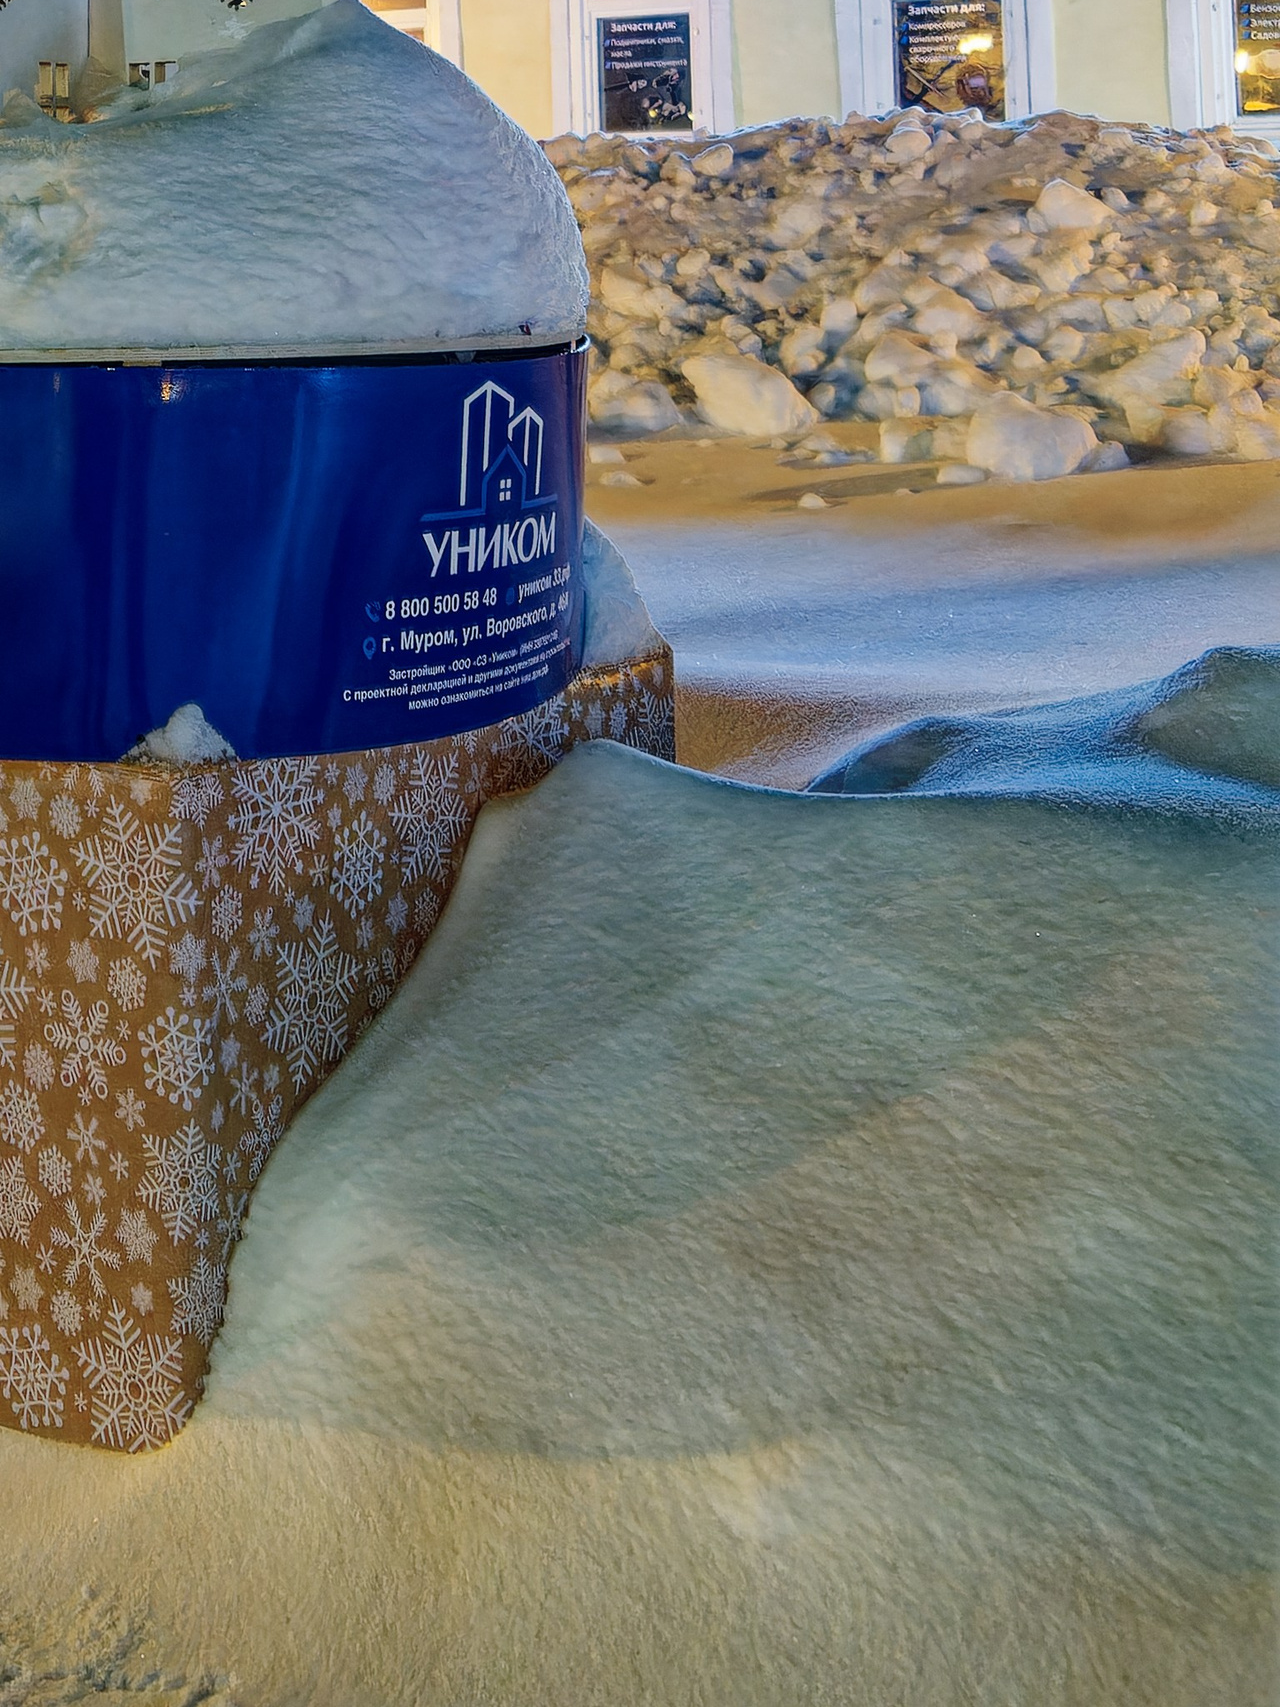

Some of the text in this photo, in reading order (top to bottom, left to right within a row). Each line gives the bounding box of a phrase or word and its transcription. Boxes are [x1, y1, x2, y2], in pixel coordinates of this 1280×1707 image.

[908, 3, 958, 15] Запчасти
[610, 22, 653, 33] Запчасти
[422, 511, 557, 578] УНИКОМ
[517, 574, 552, 604] уником
[385, 587, 497, 620] 8 800 500 58 48
[382, 637, 395, 653] г.
[400, 629, 458, 654] Муром,
[462, 624, 482, 646] ул.
[486, 606, 548, 639] Воровского,
[389, 664, 446, 681] Застройщик
[343, 689, 352, 702] С
[354, 683, 409, 702] проектной
[410, 674, 467, 695] декларацией
[468, 675, 473, 685] и
[408, 698, 439, 710] можно
